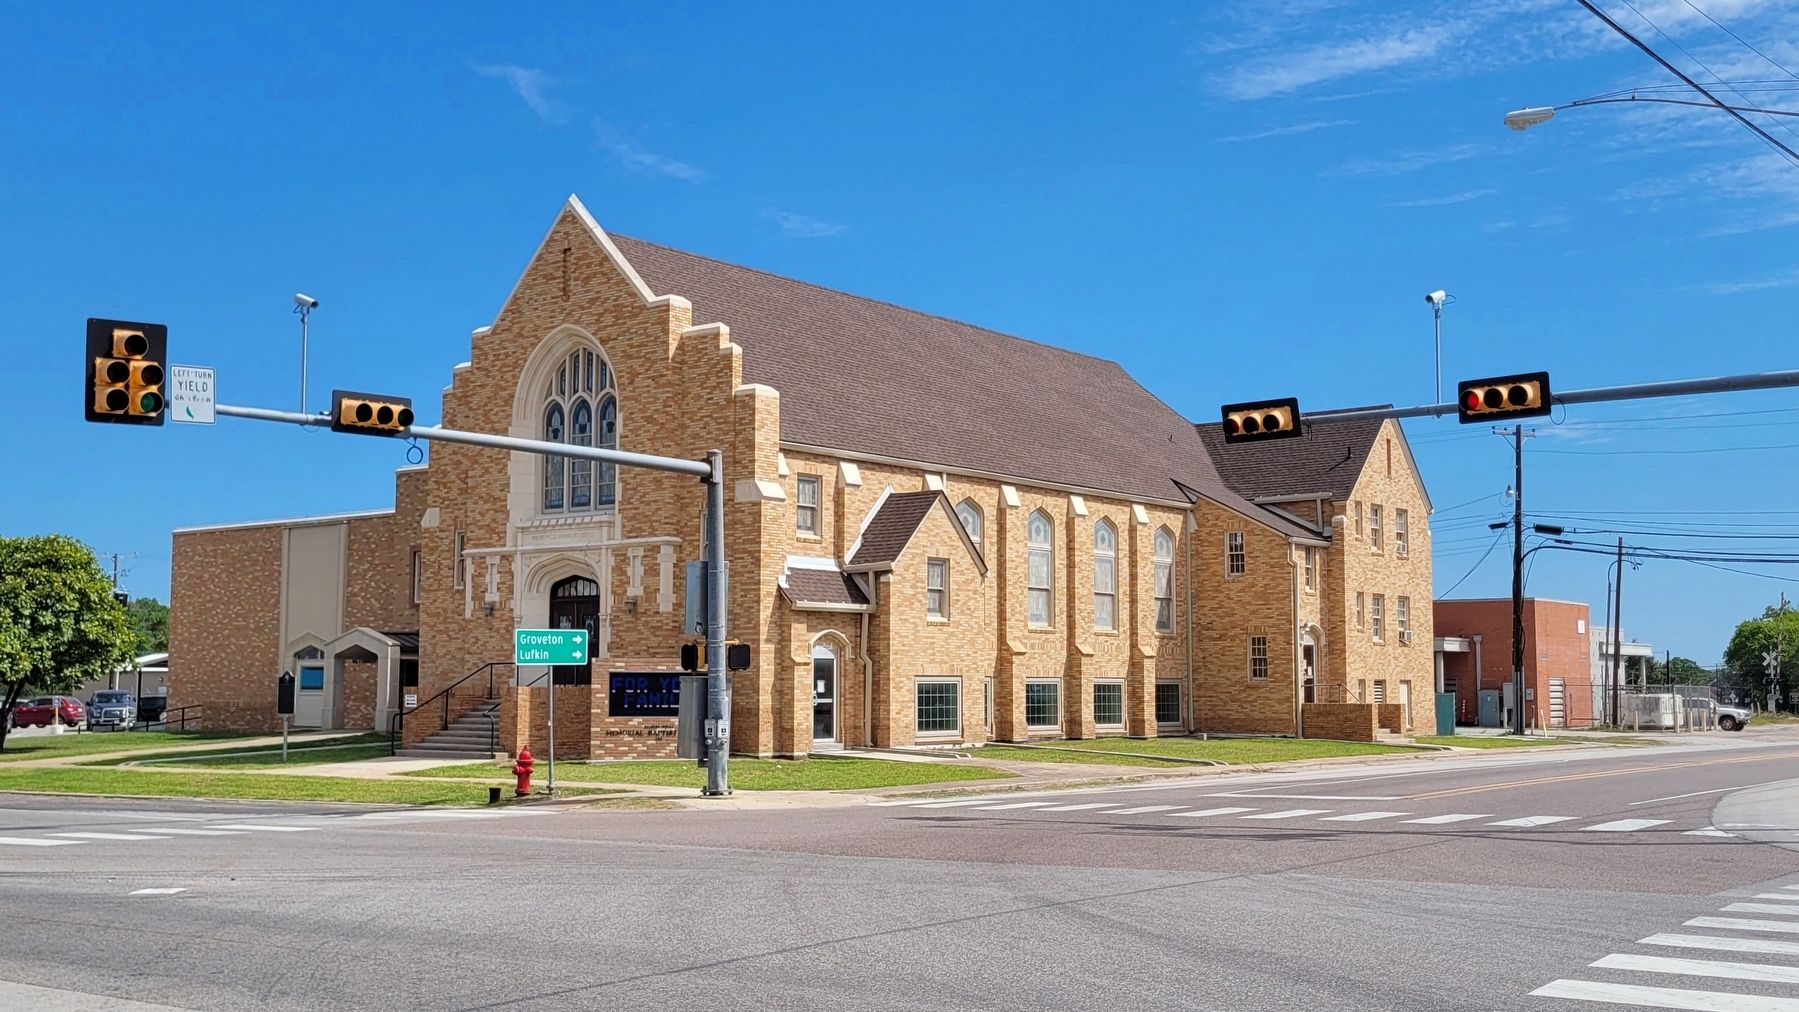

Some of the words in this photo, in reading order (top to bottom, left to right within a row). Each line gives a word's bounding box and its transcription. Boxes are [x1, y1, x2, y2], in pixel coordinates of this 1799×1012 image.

[194, 370, 212, 379] TURN
[178, 380, 208, 393] YIELD
[520, 634, 564, 645] Groveton
[520, 649, 549, 660] Lufkin
[611, 677, 648, 693] FOR
[648, 729, 677, 737] BAPTIST
